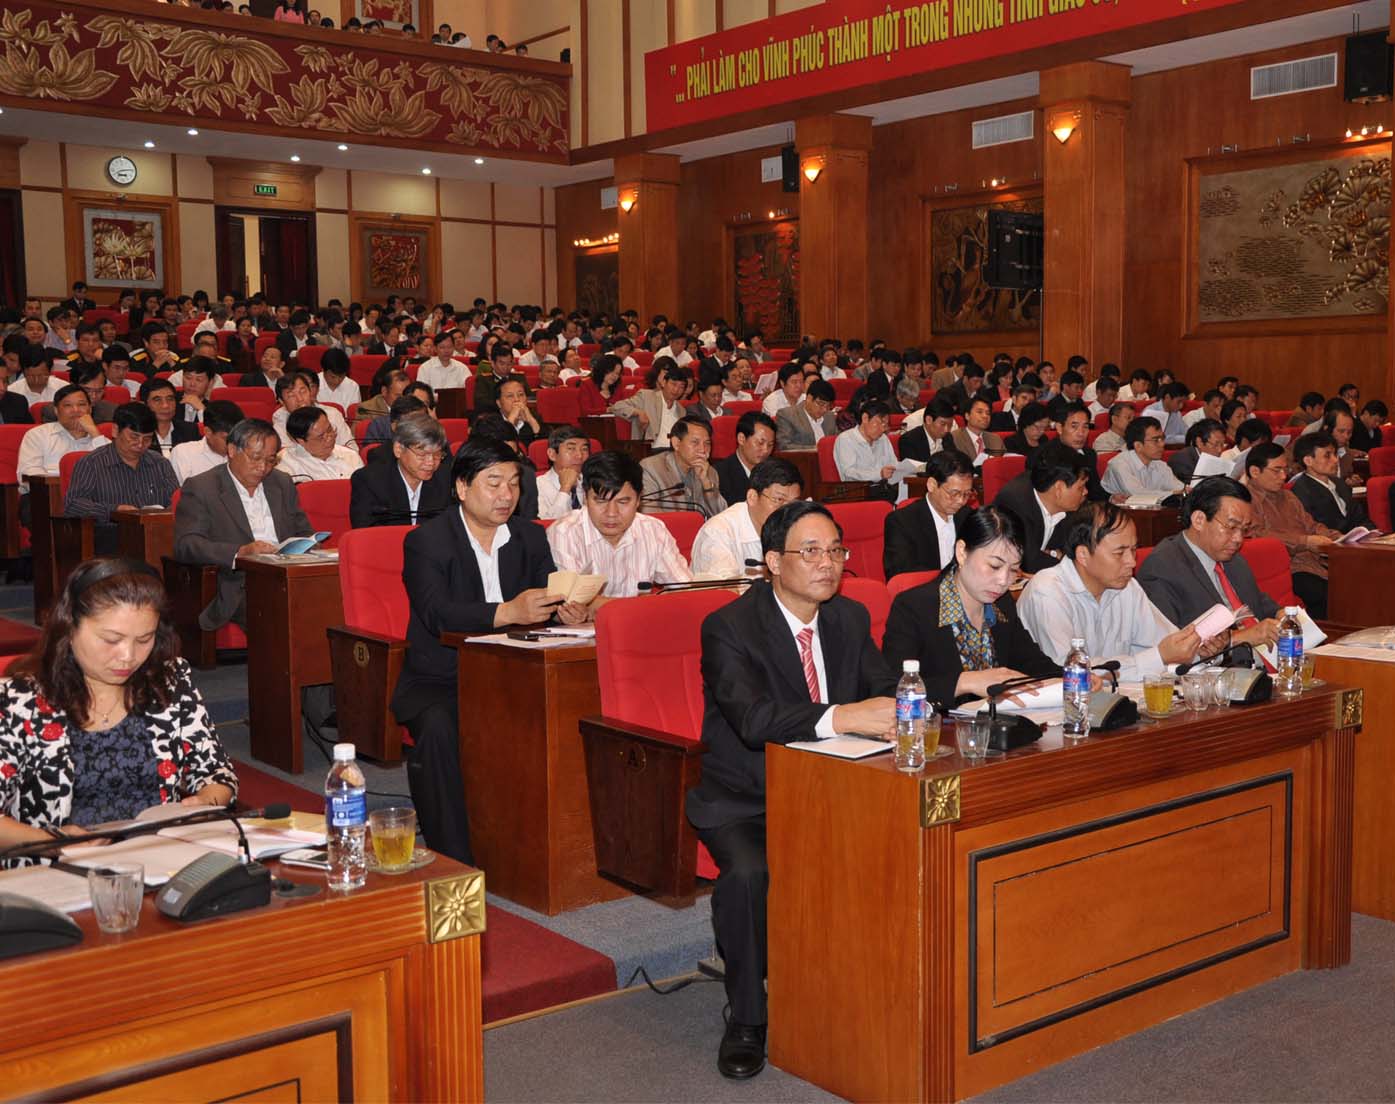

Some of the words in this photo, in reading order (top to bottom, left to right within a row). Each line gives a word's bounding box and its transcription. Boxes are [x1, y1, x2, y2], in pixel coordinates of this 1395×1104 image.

[686, 47, 711, 100] PHẢI
[713, 49, 736, 94] LÀM
[738, 48, 760, 88] CHO
[762, 36, 790, 81] VĨNH
[792, 25, 824, 74] PHÚC
[827, 15, 869, 66] THÀNH
[872, 4, 901, 62] MỘT
[903, 0, 949, 49] TRONG
